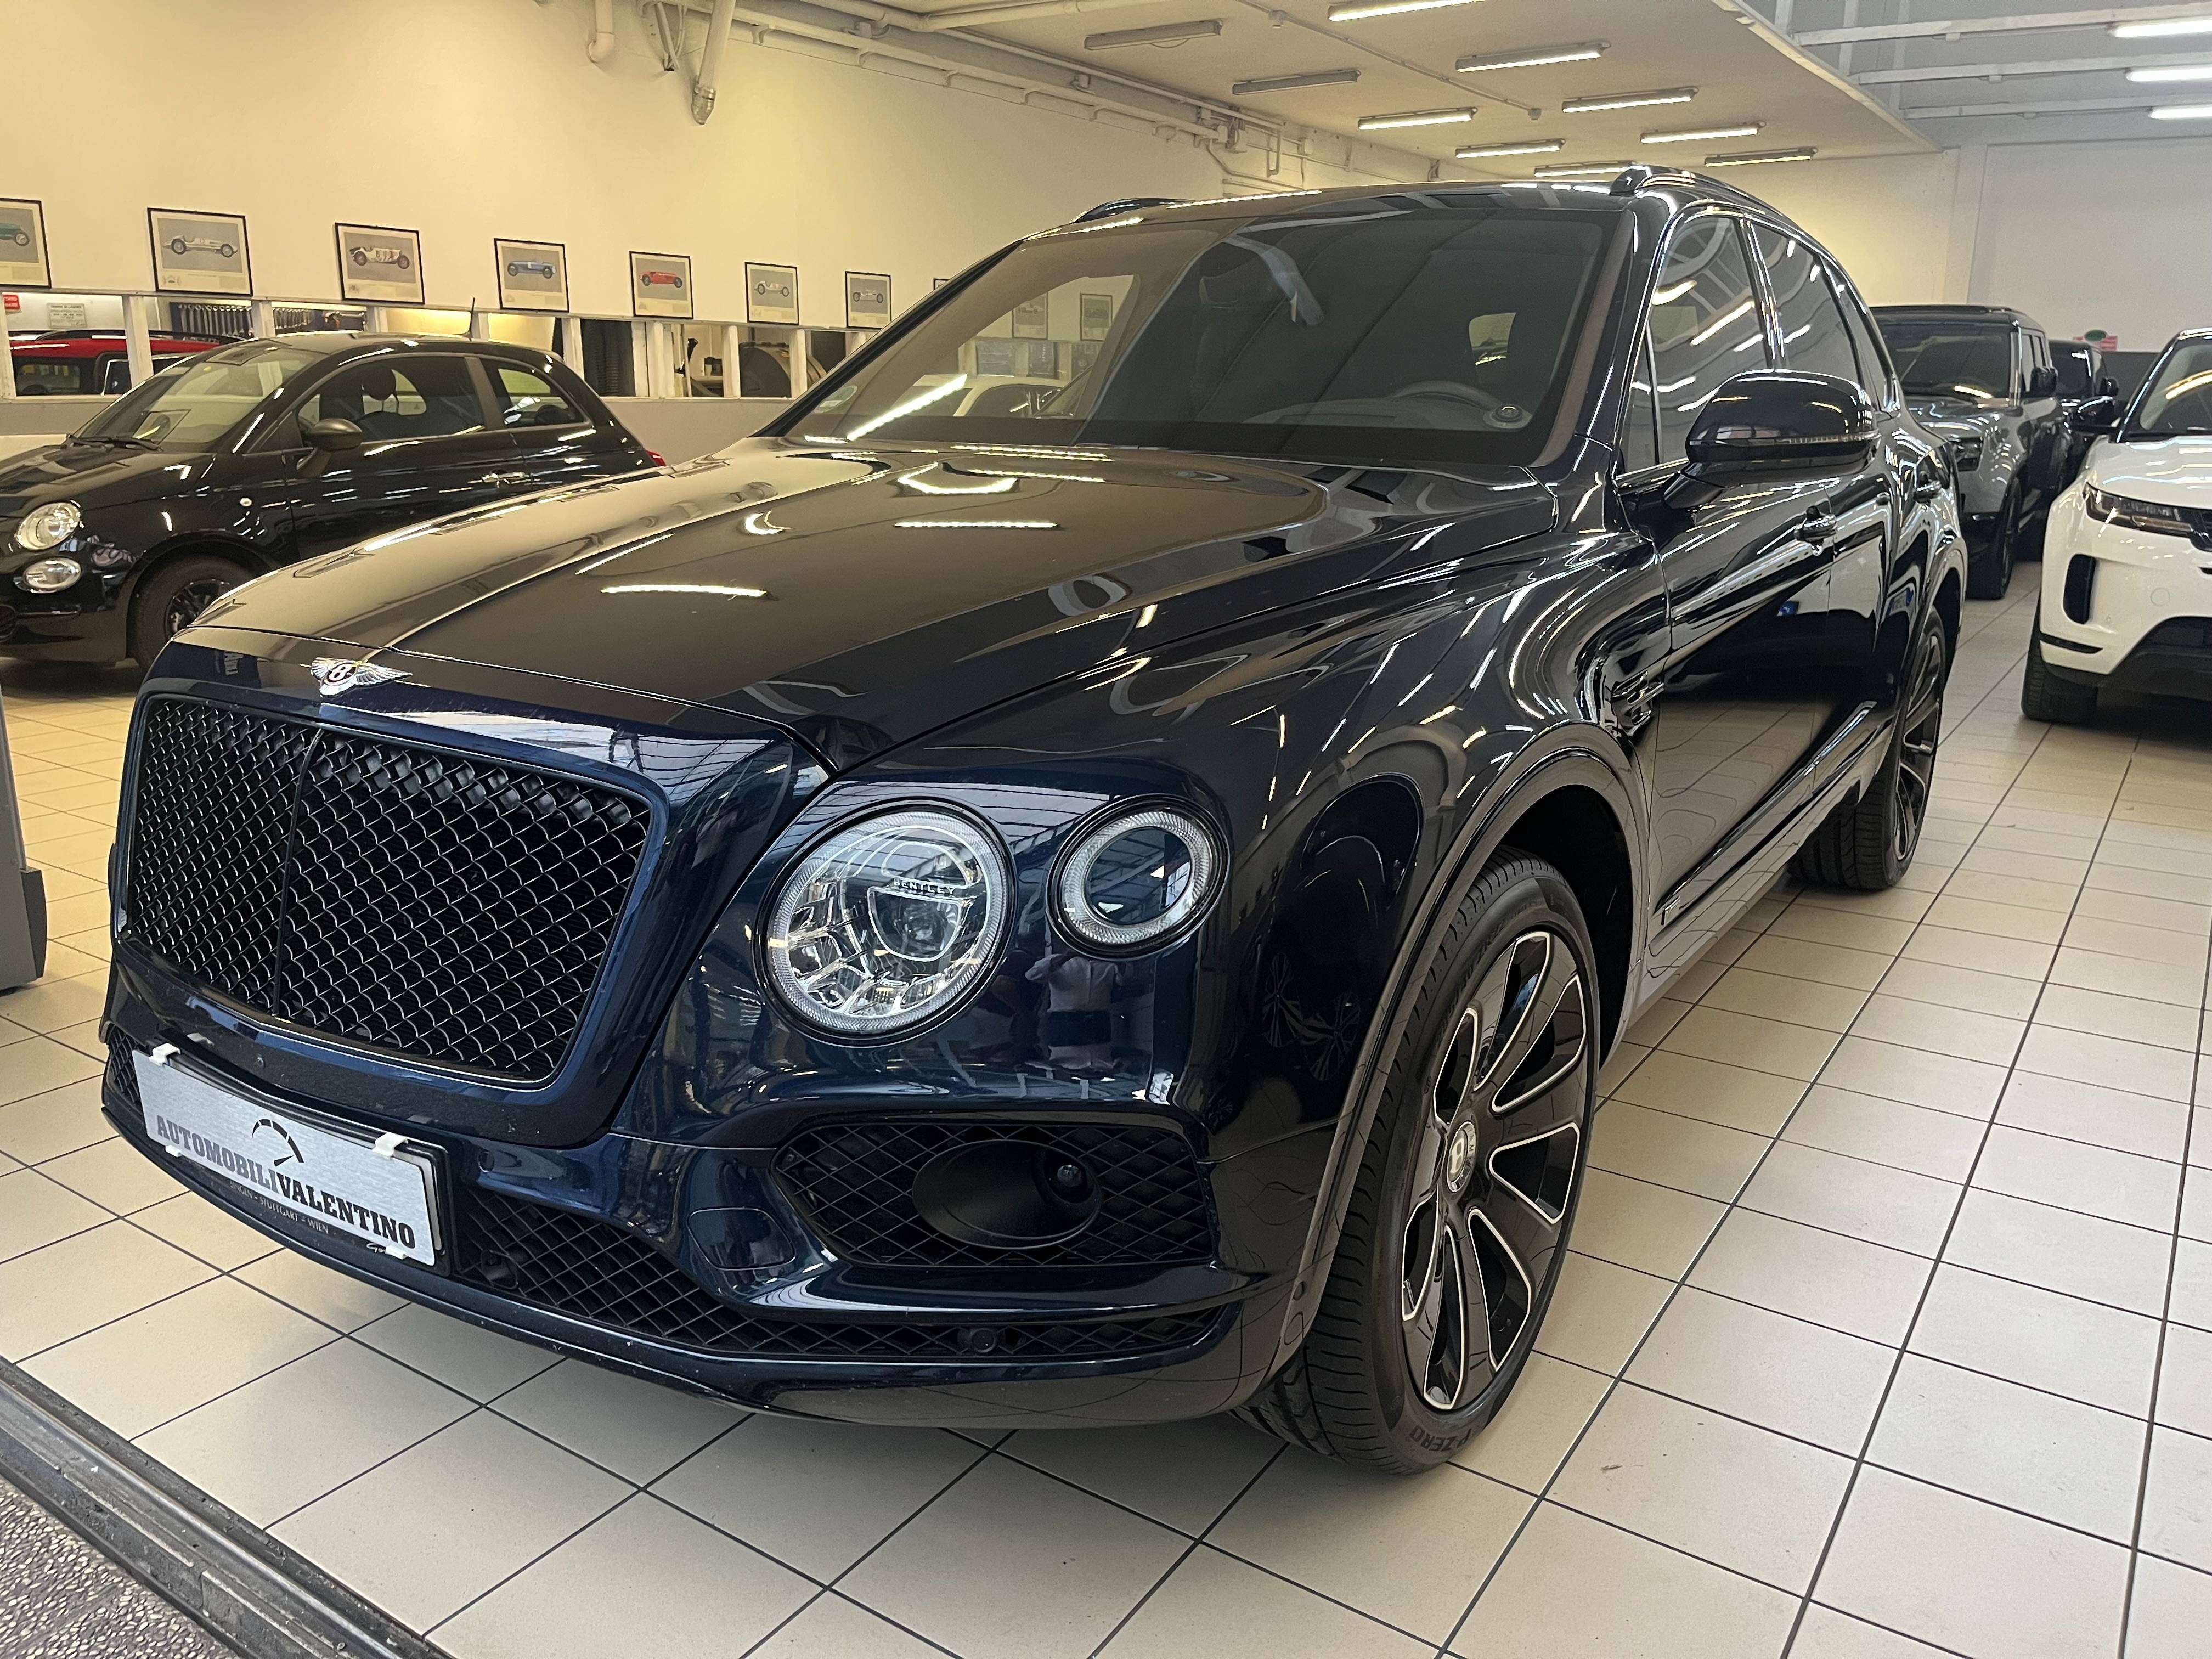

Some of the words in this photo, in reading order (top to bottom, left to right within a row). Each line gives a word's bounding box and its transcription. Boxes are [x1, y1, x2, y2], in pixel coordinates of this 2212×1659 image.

[893, 878, 955, 895] BENTLEY
[259, 1197, 298, 1221] STUTTGART
[307, 1218, 329, 1234] WIEN
[1408, 1425, 1458, 1452] ZERO
